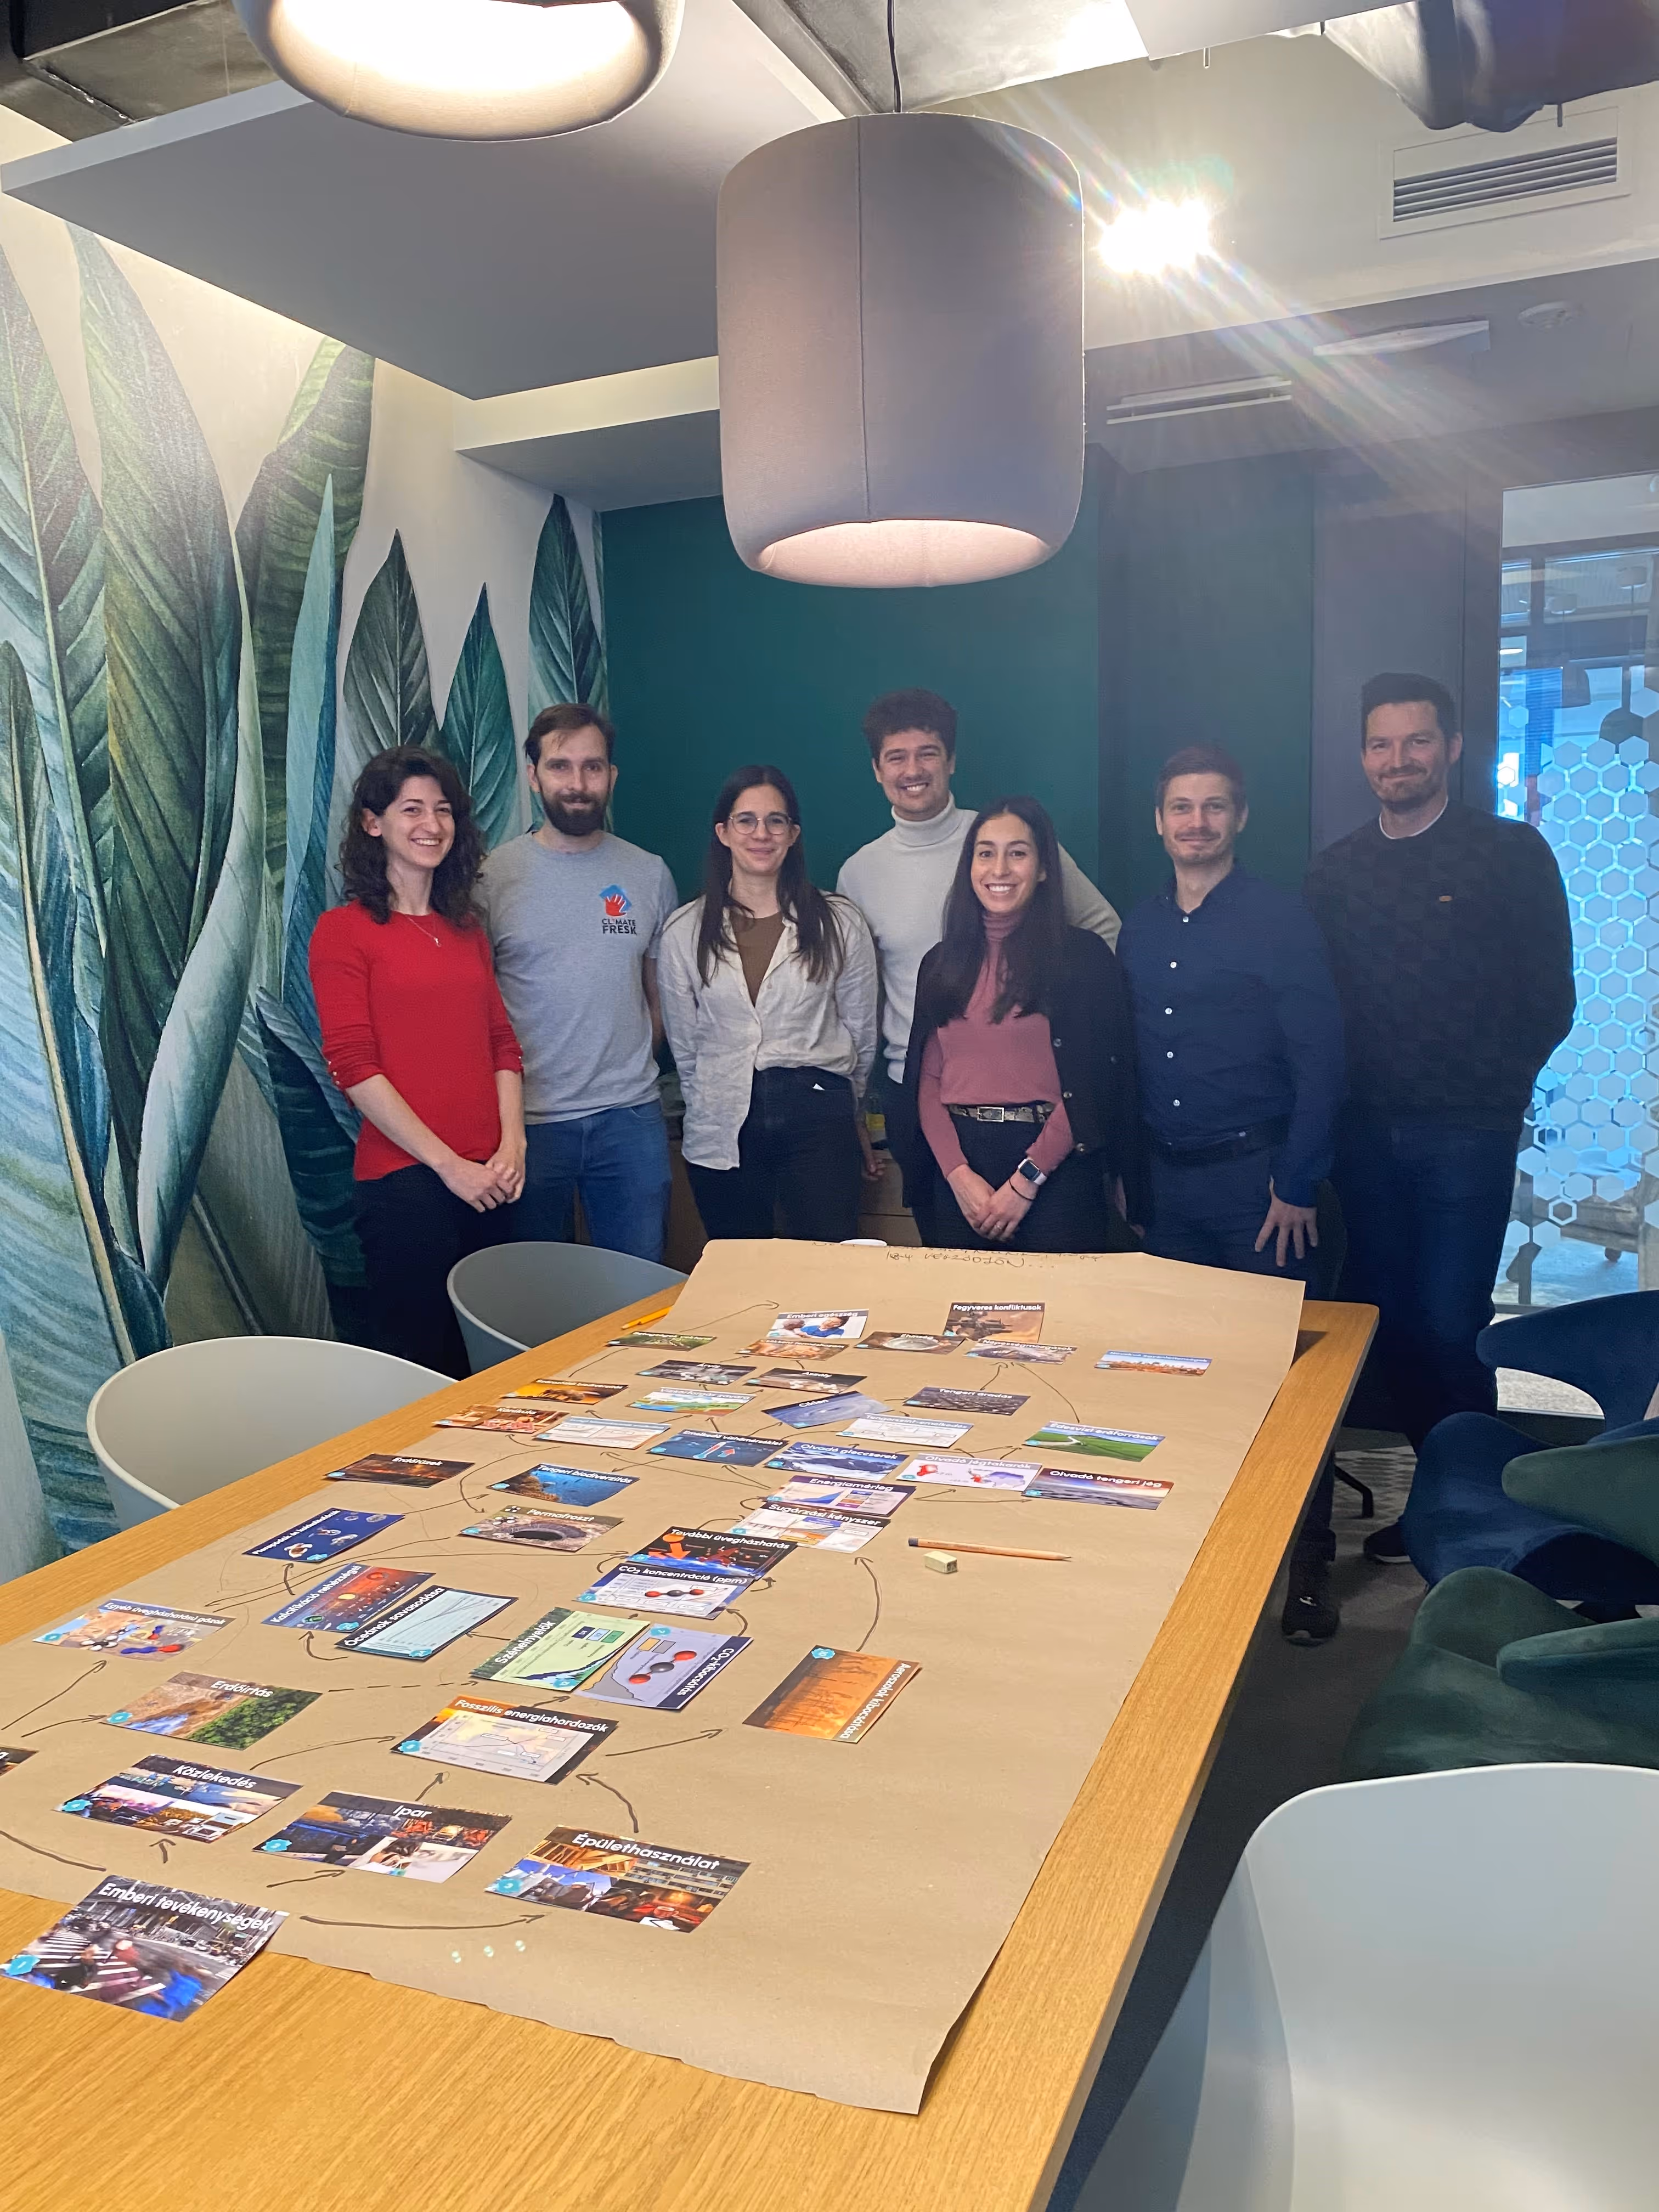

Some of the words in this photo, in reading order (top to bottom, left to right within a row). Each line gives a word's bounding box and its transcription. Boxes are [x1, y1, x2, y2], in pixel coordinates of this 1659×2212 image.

[602, 925, 637, 935] FRESK
[983, 1339, 1073, 1352] Népességmozgások
[798, 1398, 829, 1408] Ciklon
[939, 1388, 975, 1396] Tengeri
[977, 1391, 1013, 1399] áradás
[496, 1406, 537, 1415] Kánikula
[1050, 1422, 1093, 1432] Édesvízi
[1094, 1429, 1159, 1441] erőforrások
[800, 1443, 839, 1453] Olvadó
[840, 1449, 898, 1460] gleccserek
[391, 1457, 443, 1467] Erdőtüzek
[925, 1455, 967, 1464] Olvadó
[968, 1458, 1031, 1470] jégtakarók
[537, 1464, 572, 1476] Tengeri
[572, 1469, 633, 1484] biodiverzitás
[1049, 1470, 1094, 1480] Olvadó
[1096, 1475, 1139, 1487] tengeri
[1139, 1480, 1163, 1489] jég
[809, 1477, 895, 1493] Energiamérleg
[527, 1509, 595, 1522] Permafroszt
[768, 1504, 827, 1519] Sugárzási
[827, 1512, 881, 1527] kényszer
[670, 1529, 713, 1540] További
[713, 1534, 791, 1550] üvegházhatás
[642, 1567, 711, 1581] koncentráció
[712, 1575, 748, 1585] (ppm)
[270, 1591, 320, 1624] Kalcifikáció
[318, 1565, 362, 1595] nehézségei
[104, 1602, 132, 1612] Egyéb
[132, 1606, 195, 1622] üvegházhatású
[196, 1616, 226, 1626] gázok
[344, 1620, 393, 1646] Óceánok
[389, 1587, 445, 1621] savasodása
[494, 1618, 557, 1664] Szénelnyelők
[210, 1680, 274, 1699] Erdőirtás
[876, 1662, 911, 1698] Aeroszolok
[454, 1699, 504, 1714] Fosszilis
[504, 1709, 609, 1734] energiahordozók
[839, 1695, 884, 1739] kibocsátása
[172, 1764, 258, 1790] Közlekedés
[392, 1804, 432, 1819] Ipar
[571, 1832, 720, 1871] Épülethasználat
[98, 1882, 158, 1906] Emberi
[157, 1895, 274, 1934] tevékenységek
